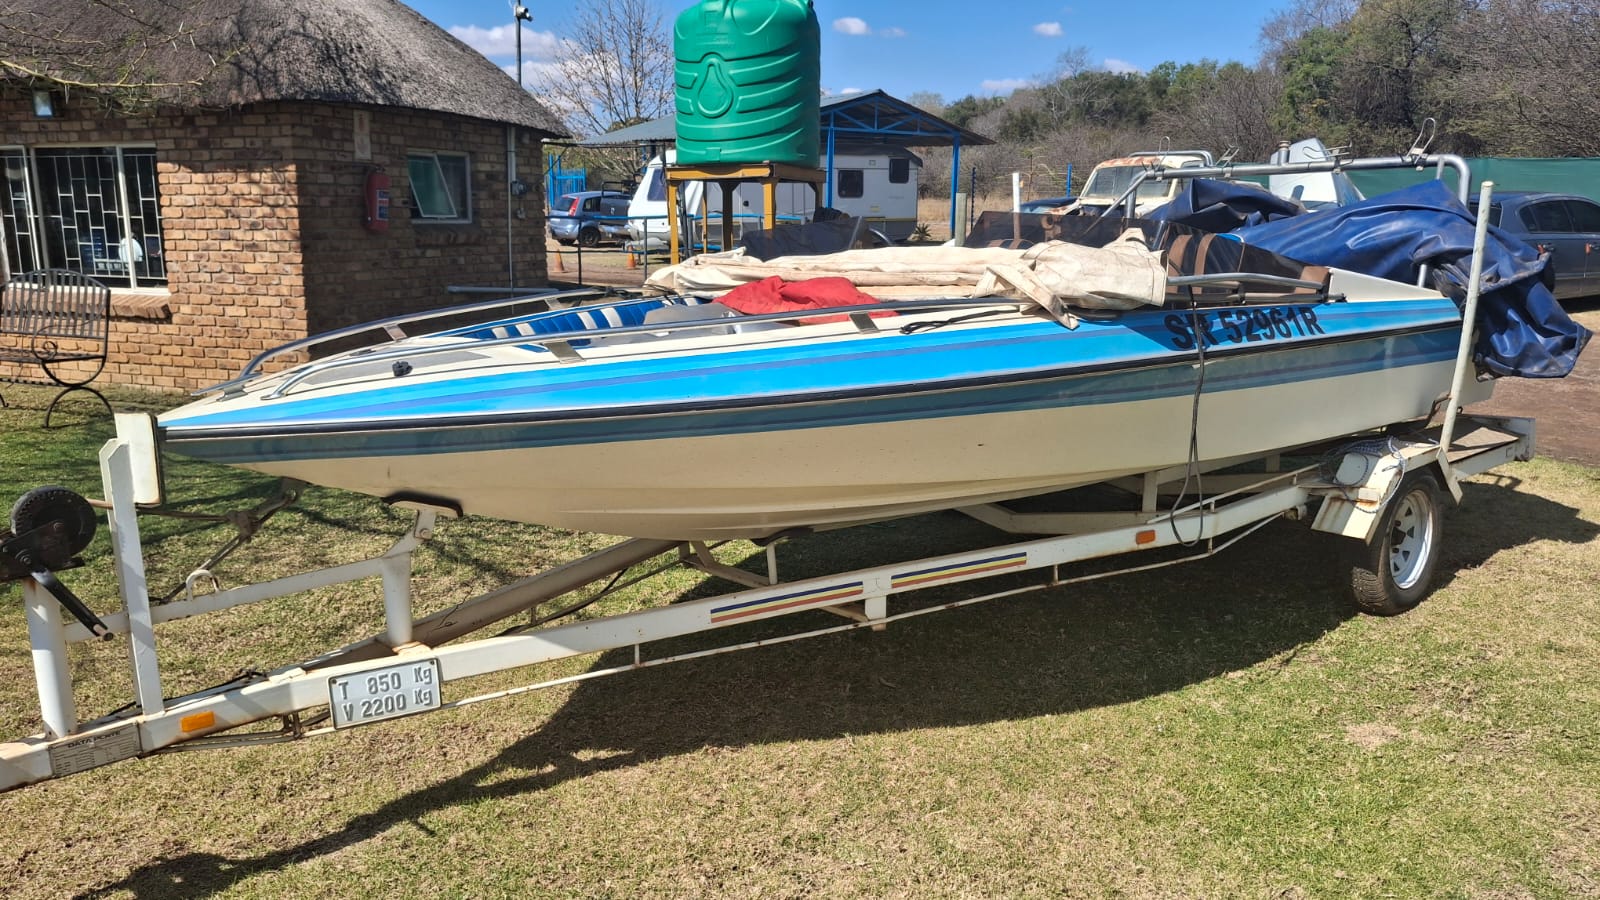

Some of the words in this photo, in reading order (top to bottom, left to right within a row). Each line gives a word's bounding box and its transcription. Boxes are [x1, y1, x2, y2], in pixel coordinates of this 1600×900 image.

[1217, 306, 1325, 343] 52961R
[338, 681, 349, 700] T
[367, 672, 402, 695] 850
[413, 667, 433, 685] Kg
[343, 703, 354, 721] V
[361, 693, 407, 718] 2200
[414, 689, 434, 706] Kg
